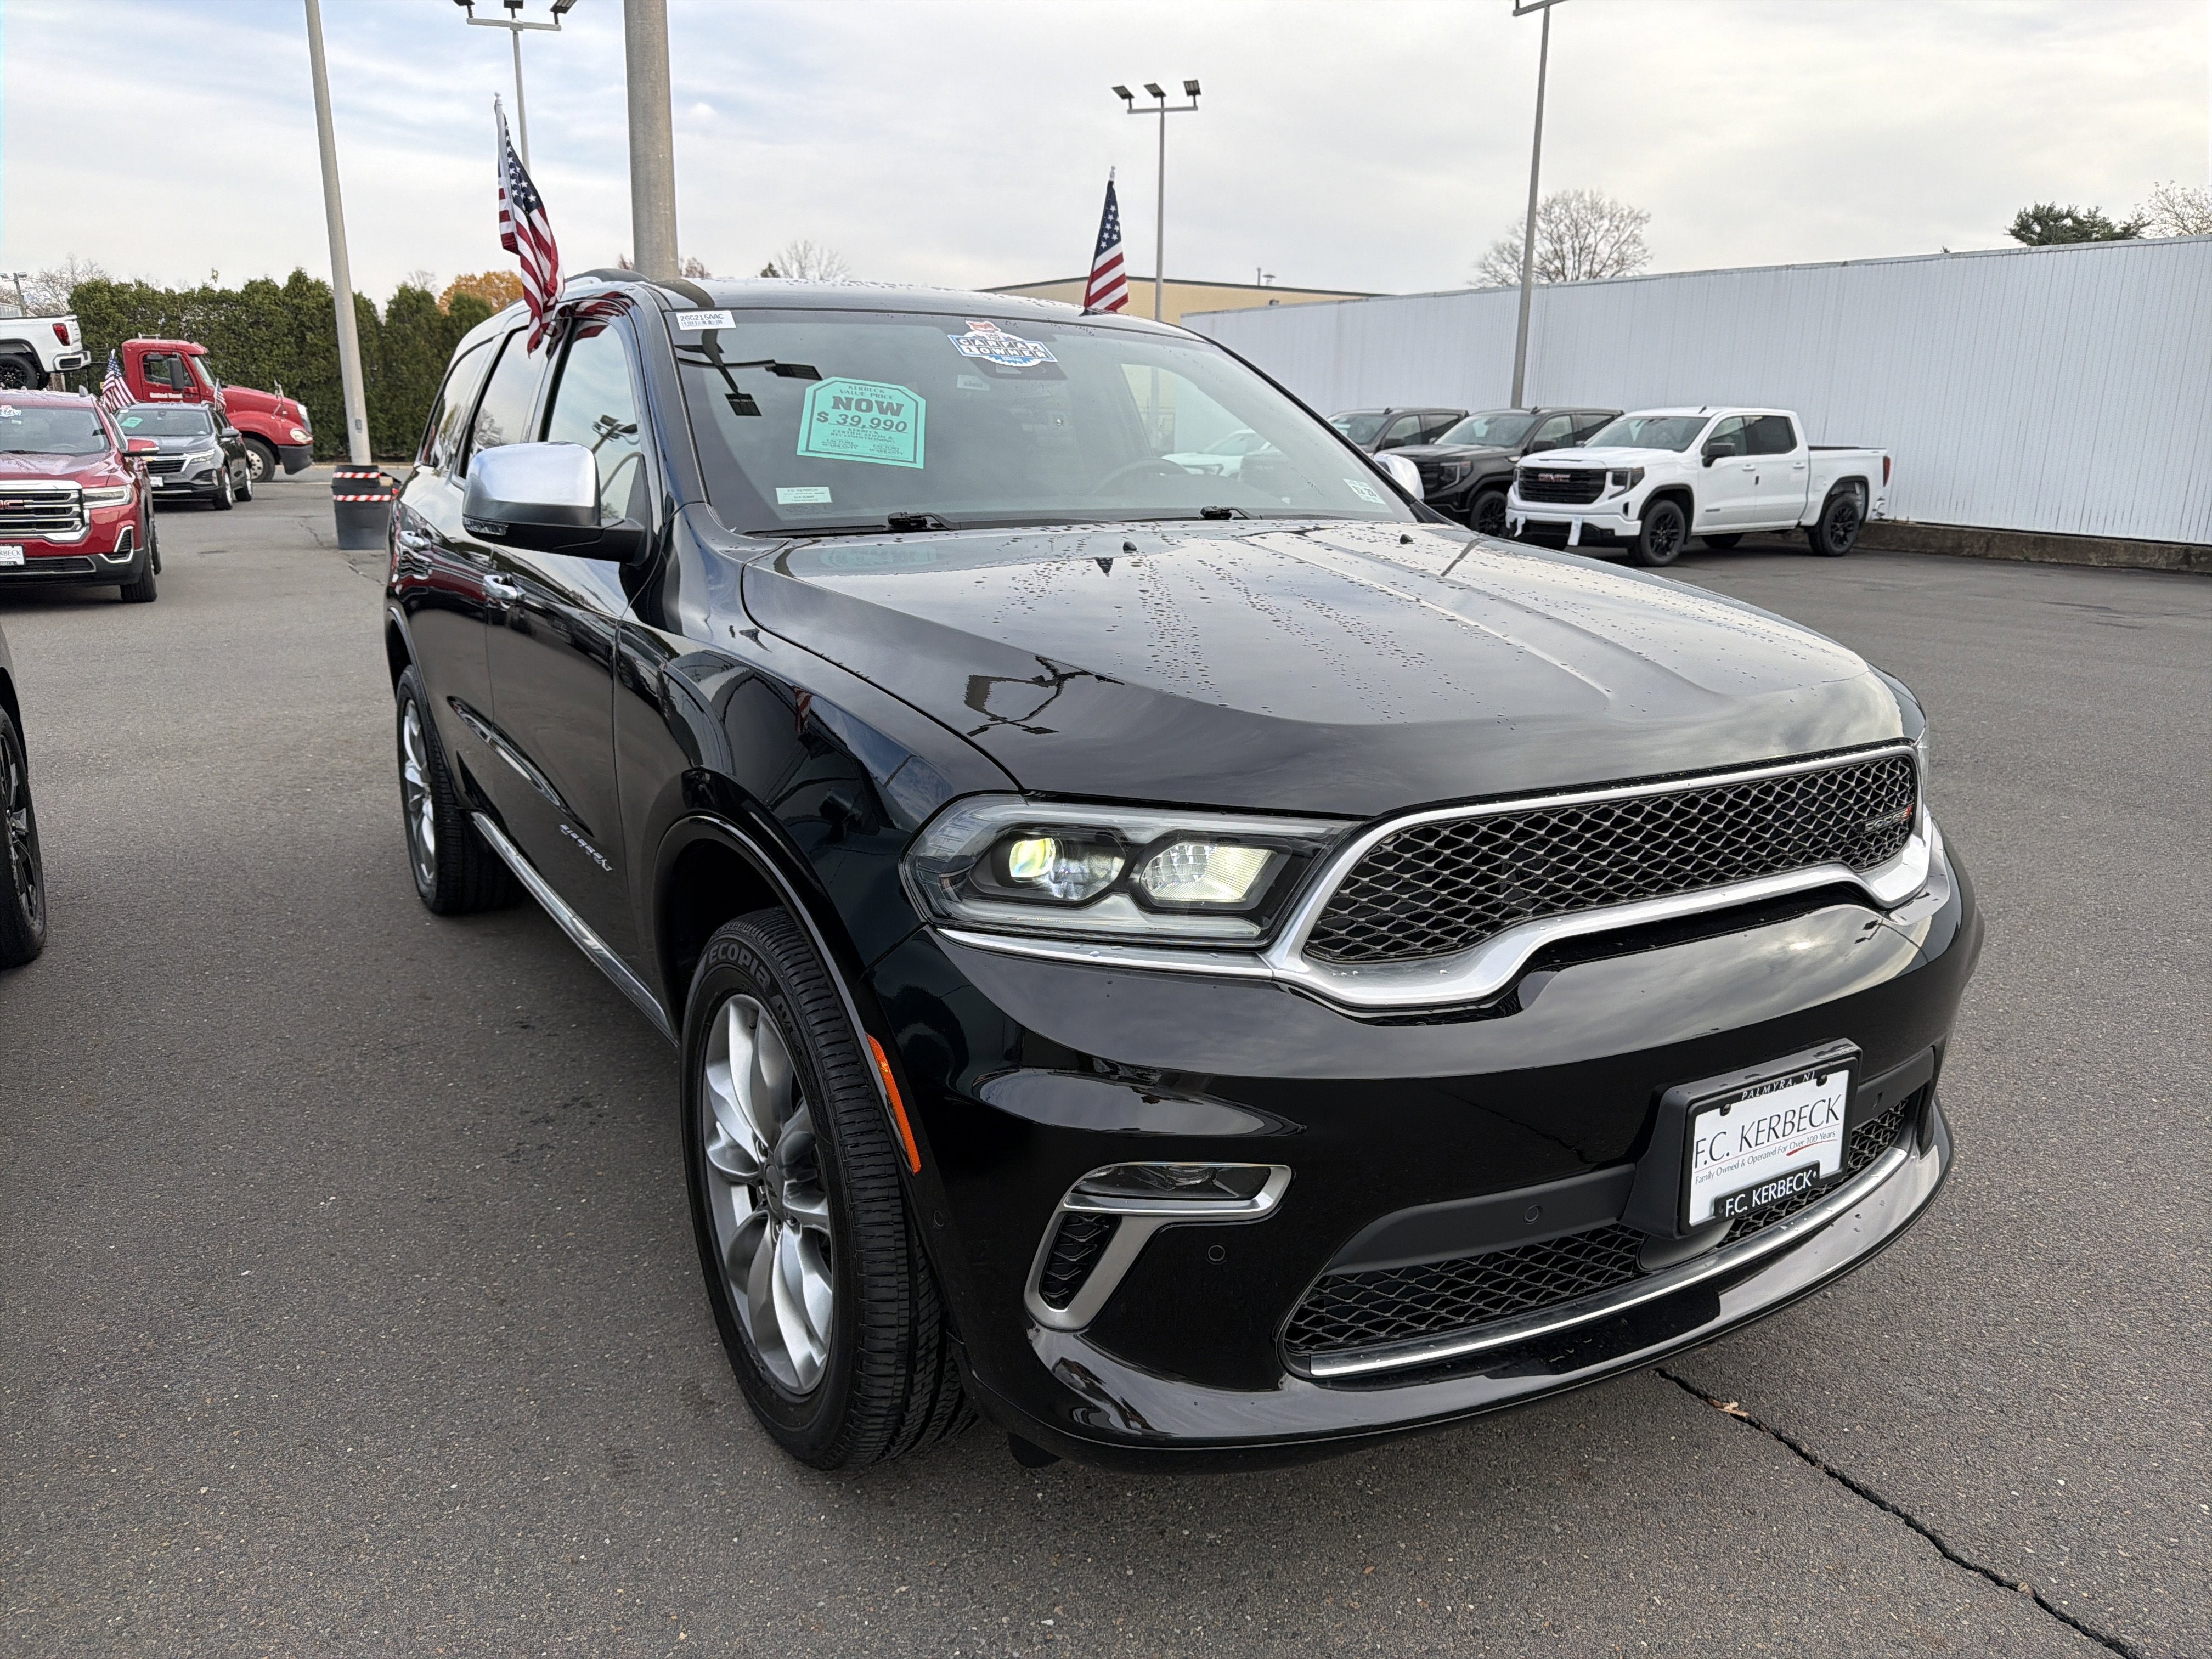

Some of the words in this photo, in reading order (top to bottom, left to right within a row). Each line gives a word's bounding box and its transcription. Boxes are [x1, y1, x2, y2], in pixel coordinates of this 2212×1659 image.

[959, 338, 1045, 352] CARFAX
[979, 347, 1047, 358] OWNER
[848, 385, 885, 393] KERBECK
[831, 396, 904, 417] NOW
[816, 411, 830, 423] $
[836, 414, 907, 432] 39,990
[831, 432, 895, 443] RECONDITIONING
[833, 430, 886, 439] CERTIFICATION
[1538, 473, 1571, 483] GMC
[1741, 1078, 1796, 1101] PALMYRA,
[1695, 1131, 1730, 1169] F.C.
[1739, 1094, 1842, 1152] KERBECK
[1695, 1170, 1715, 1185] Family
[1716, 1159, 1740, 1176] Owned
[1740, 1158, 1745, 1167] &
[1747, 1147, 1777, 1165] Operated
[1778, 1145, 1788, 1154] For
[1790, 1140, 1805, 1150] Over
[1807, 1134, 1818, 1144] 100
[1820, 1131, 1836, 1140] Years
[1725, 1194, 1748, 1217] F.C.
[1752, 1169, 1812, 1207] KERBECK
